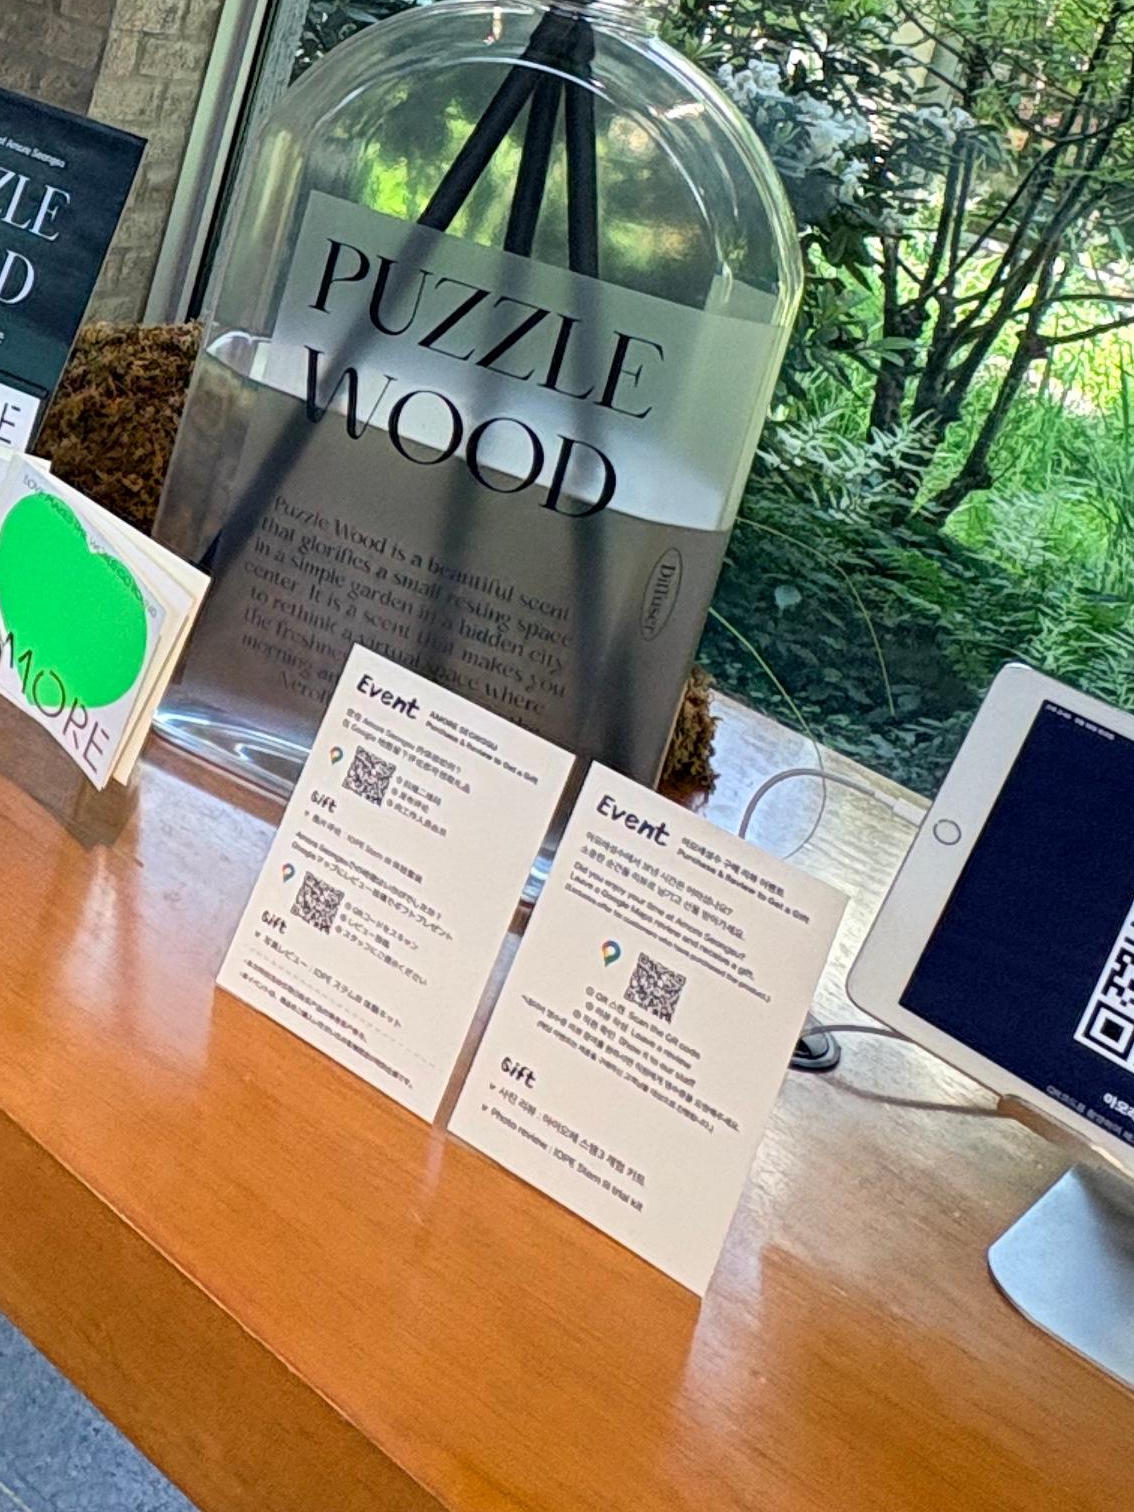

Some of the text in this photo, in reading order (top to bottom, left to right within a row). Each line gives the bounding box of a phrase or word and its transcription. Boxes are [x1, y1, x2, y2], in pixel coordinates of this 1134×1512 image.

[308, 238, 665, 420] PUZZLE
[302, 344, 617, 520] WOOD
[296, 530, 374, 578] glorifies
[330, 516, 388, 554] Wood
[389, 538, 409, 562] is
[409, 546, 425, 568] a
[426, 552, 515, 602] beautiful
[271, 594, 340, 634] rethink
[287, 553, 347, 593] simple
[347, 577, 414, 621] garden
[456, 619, 526, 659] hidden
[355, 671, 422, 721] Event
[309, 789, 338, 814] Gift
[595, 789, 673, 849] Event
[260, 908, 288, 935] Gift
[499, 1053, 538, 1090] Gift
